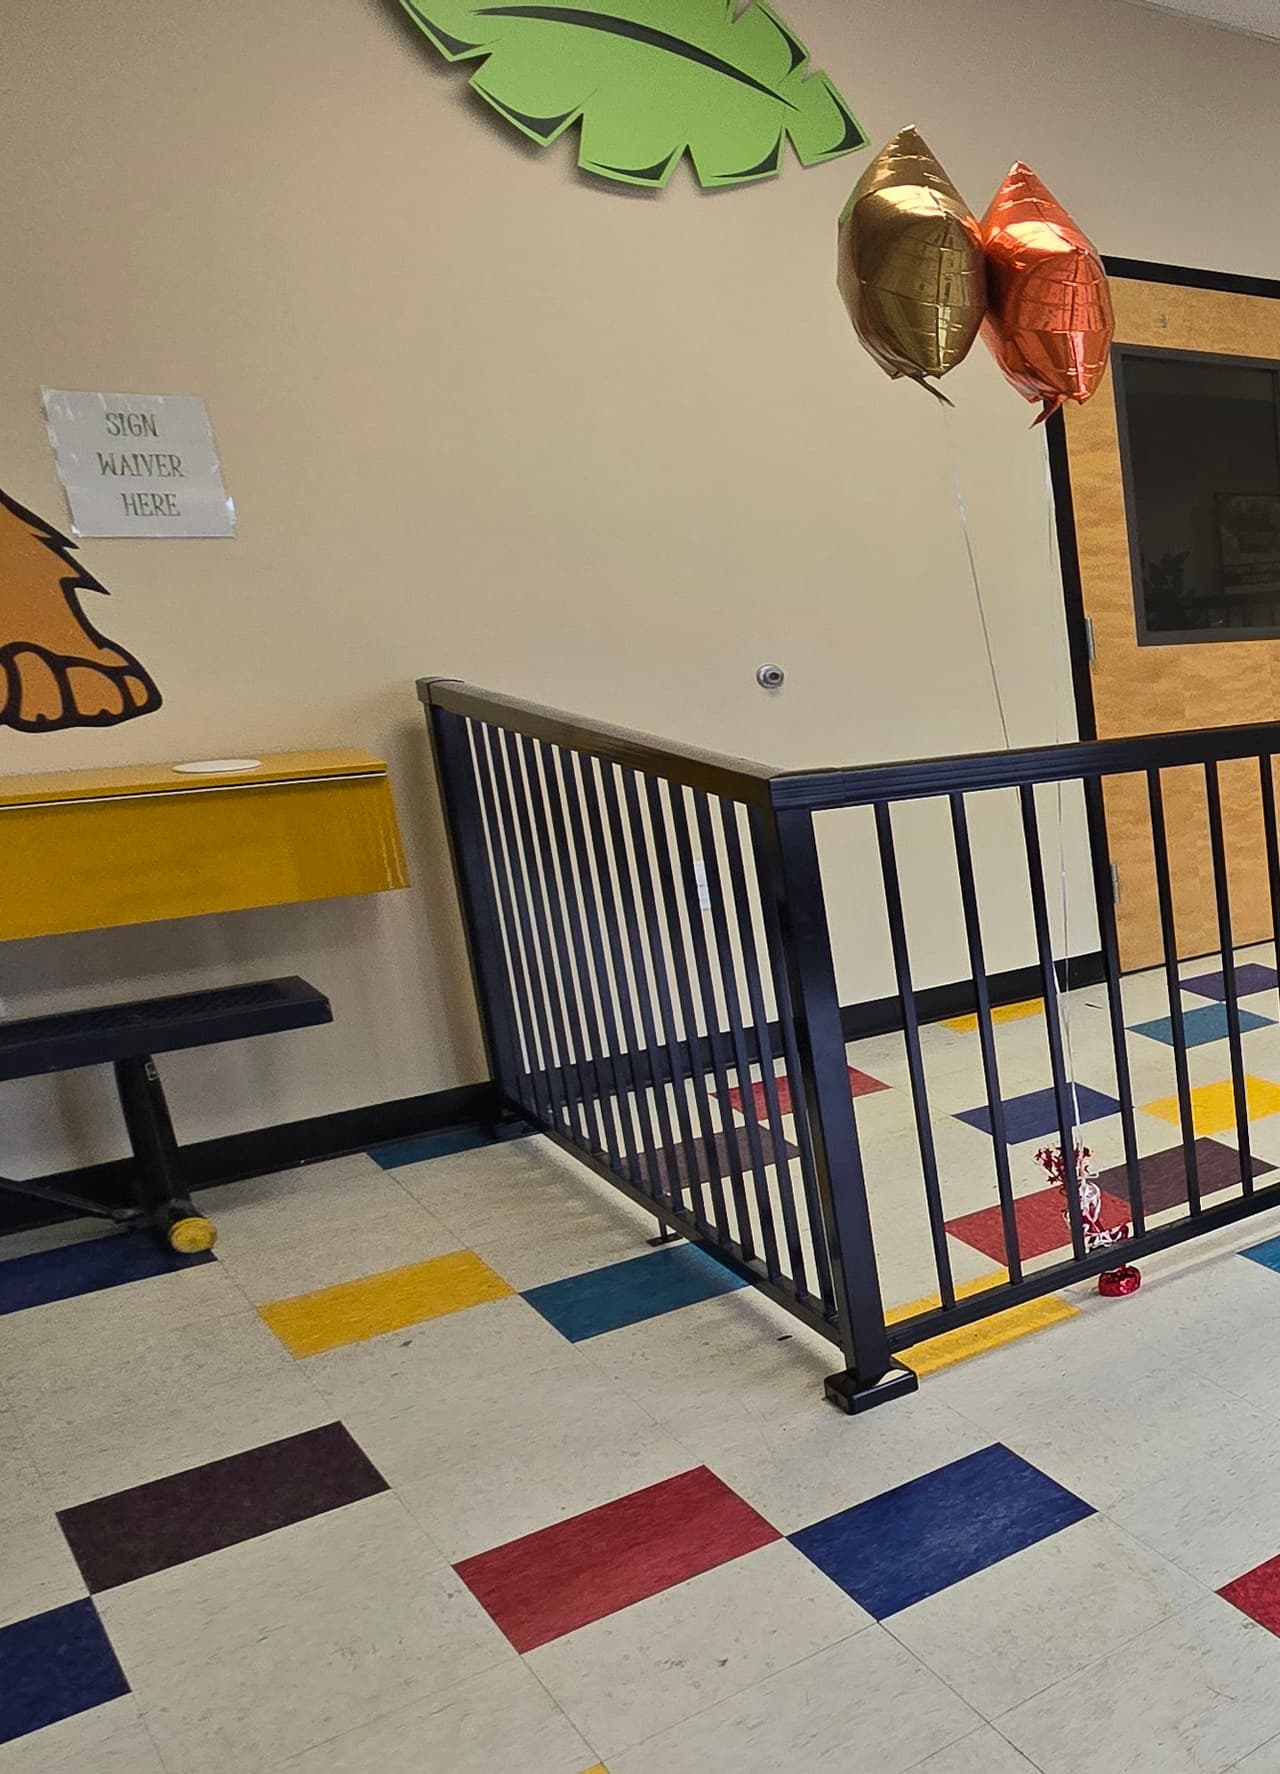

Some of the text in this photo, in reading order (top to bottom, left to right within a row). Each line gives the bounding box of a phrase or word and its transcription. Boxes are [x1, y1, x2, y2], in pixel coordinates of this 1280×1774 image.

[106, 412, 159, 437] SIGN
[96, 452, 184, 477] WAIVER
[120, 493, 181, 517] HERE
